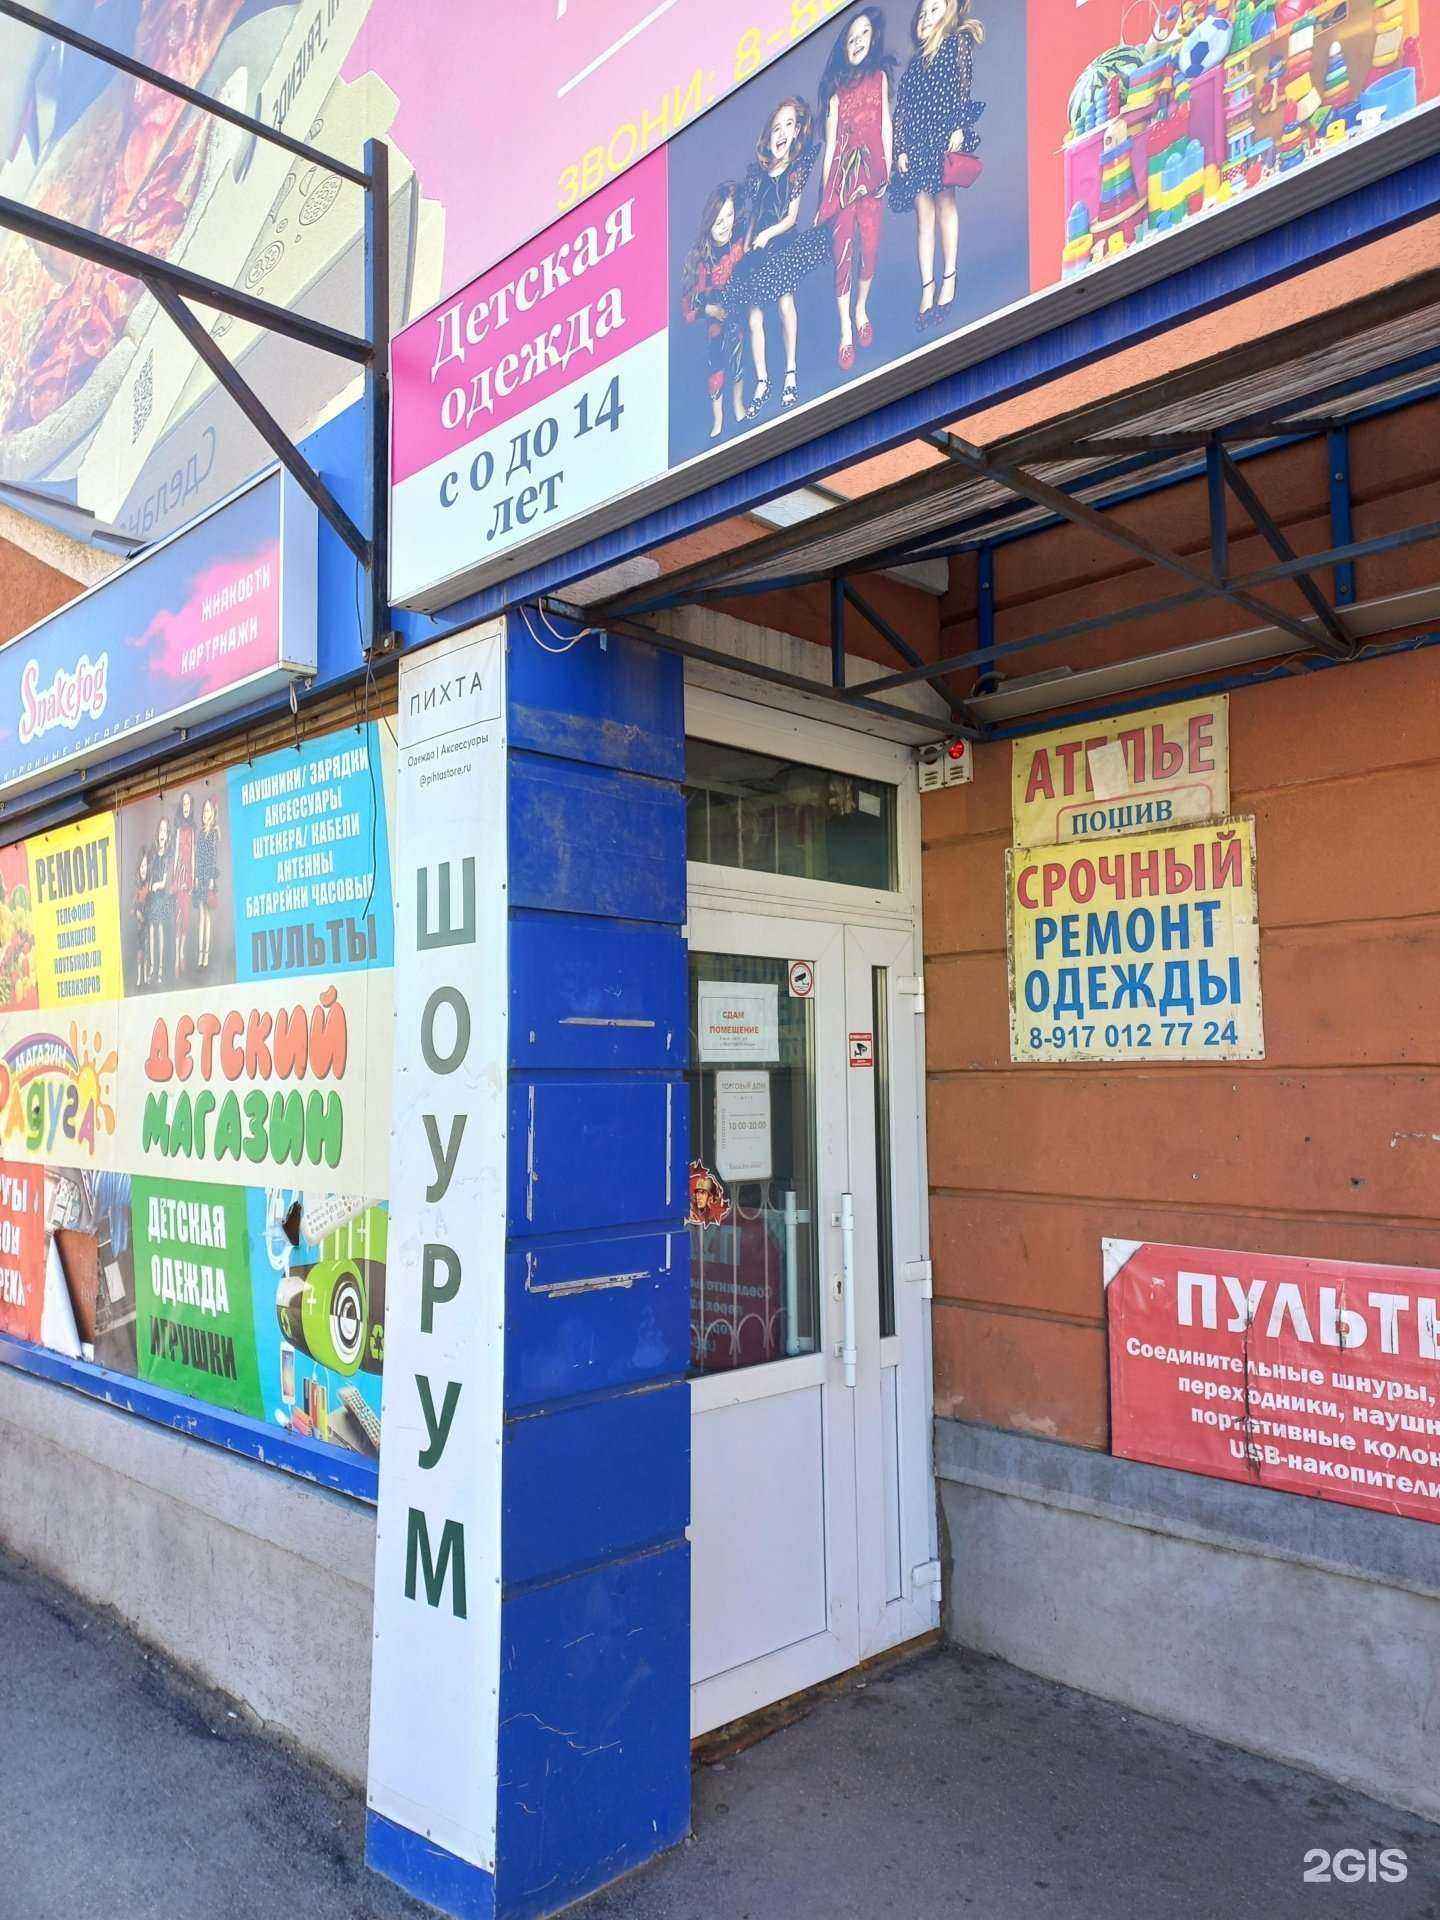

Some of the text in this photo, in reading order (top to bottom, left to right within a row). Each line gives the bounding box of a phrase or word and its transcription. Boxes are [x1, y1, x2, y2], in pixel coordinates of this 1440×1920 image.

[557, 68, 717, 211] ЗВОНИ:
[431, 197, 636, 384] Детская
[440, 287, 626, 430] одежда
[505, 417, 559, 486] до
[573, 375, 625, 439] 14
[486, 470, 564, 542] лет
[202, 563, 271, 622] ЖИДКОСТИ
[181, 616, 259, 675] КАРТРИДЖИ
[20, 654, 107, 742] Snakefog
[410, 672, 482, 716] ПИХТА
[309, 746, 369, 785] ЗАРЯДКИ
[407, 734, 489, 768] Одежда Аксессуары
[264, 785, 343, 828] АКСЕССУАРЫ
[311, 812, 360, 846] КАБЕЛИ
[35, 836, 110, 904] РЕМОНТ
[276, 850, 334, 883] АНТЕННЫ
[1017, 829, 1243, 909] СРОЧНЫЙ
[56, 901, 95, 926] ТЕЛЕФОНОВ
[245, 884, 309, 919] БАТАРЕЙКИ
[1035, 900, 1221, 960] РЕМОНТ
[56, 926, 96, 950] ПЛАНШЕТОВ
[251, 913, 378, 974] ПУЛЬТЫ
[56, 975, 101, 999] ТЕЛЕВИЗОРОВ
[721, 1011, 745, 1020] СДАМ
[1024, 957, 1241, 1021] ОДЕЖДЫ
[15, 1043, 67, 1073] МАГАЗИН
[144, 985, 348, 1083] ДЕТСКИЙ
[709, 1025, 759, 1035] ПОМЕЩЕНИЕ
[1030, 1020, 1238, 1049] 8-917 012 77 24
[142, 1089, 344, 1170] МАГАЗИН
[148, 1196, 227, 1250] ДЕТСКАЯ
[403, 857, 477, 1620] ШОУРУМ
[150, 1254, 230, 1318] ОДЕЖДА
[150, 1315, 238, 1382] ИГРУШКИ
[1126, 1337, 1437, 1408] Соединительные шнуры,
[1178, 1375, 1346, 1423] переходники,
[1191, 1406, 1357, 1452] портативные
